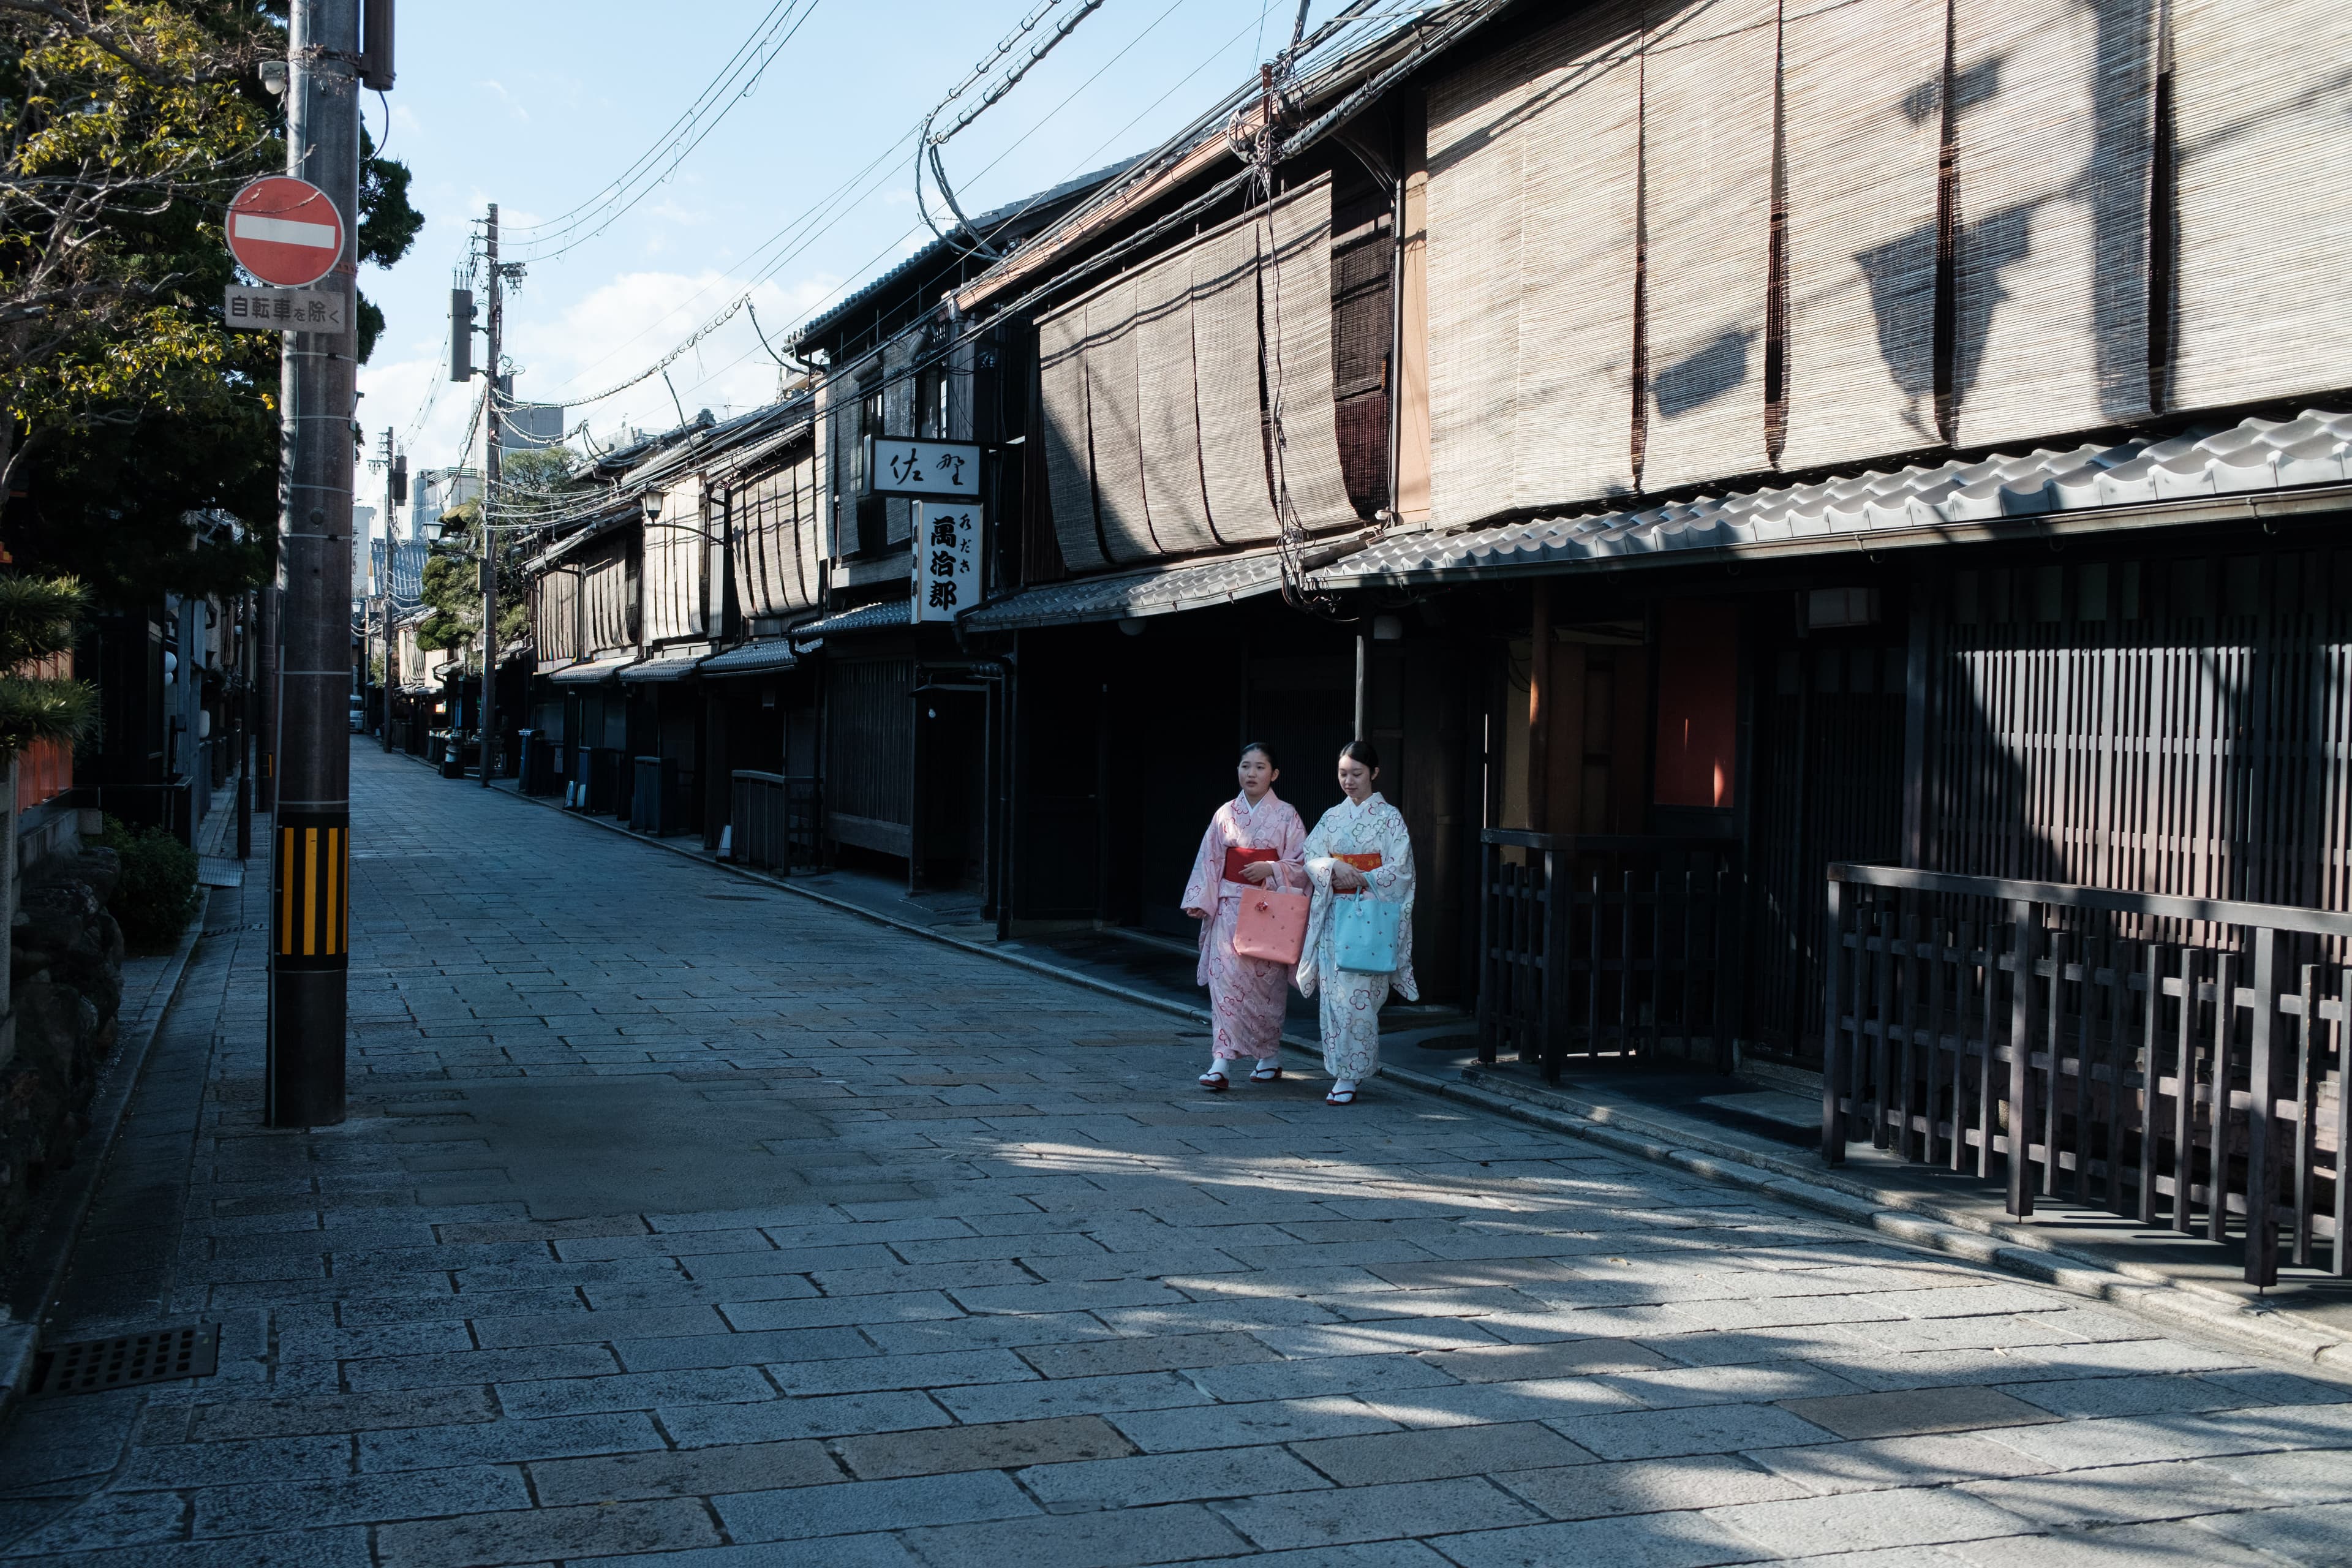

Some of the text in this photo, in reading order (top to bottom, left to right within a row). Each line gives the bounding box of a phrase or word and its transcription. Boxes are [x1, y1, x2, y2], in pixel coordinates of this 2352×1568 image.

[232, 295, 339, 324] 自転車を除く
[929, 515, 957, 611] 萬治郎
